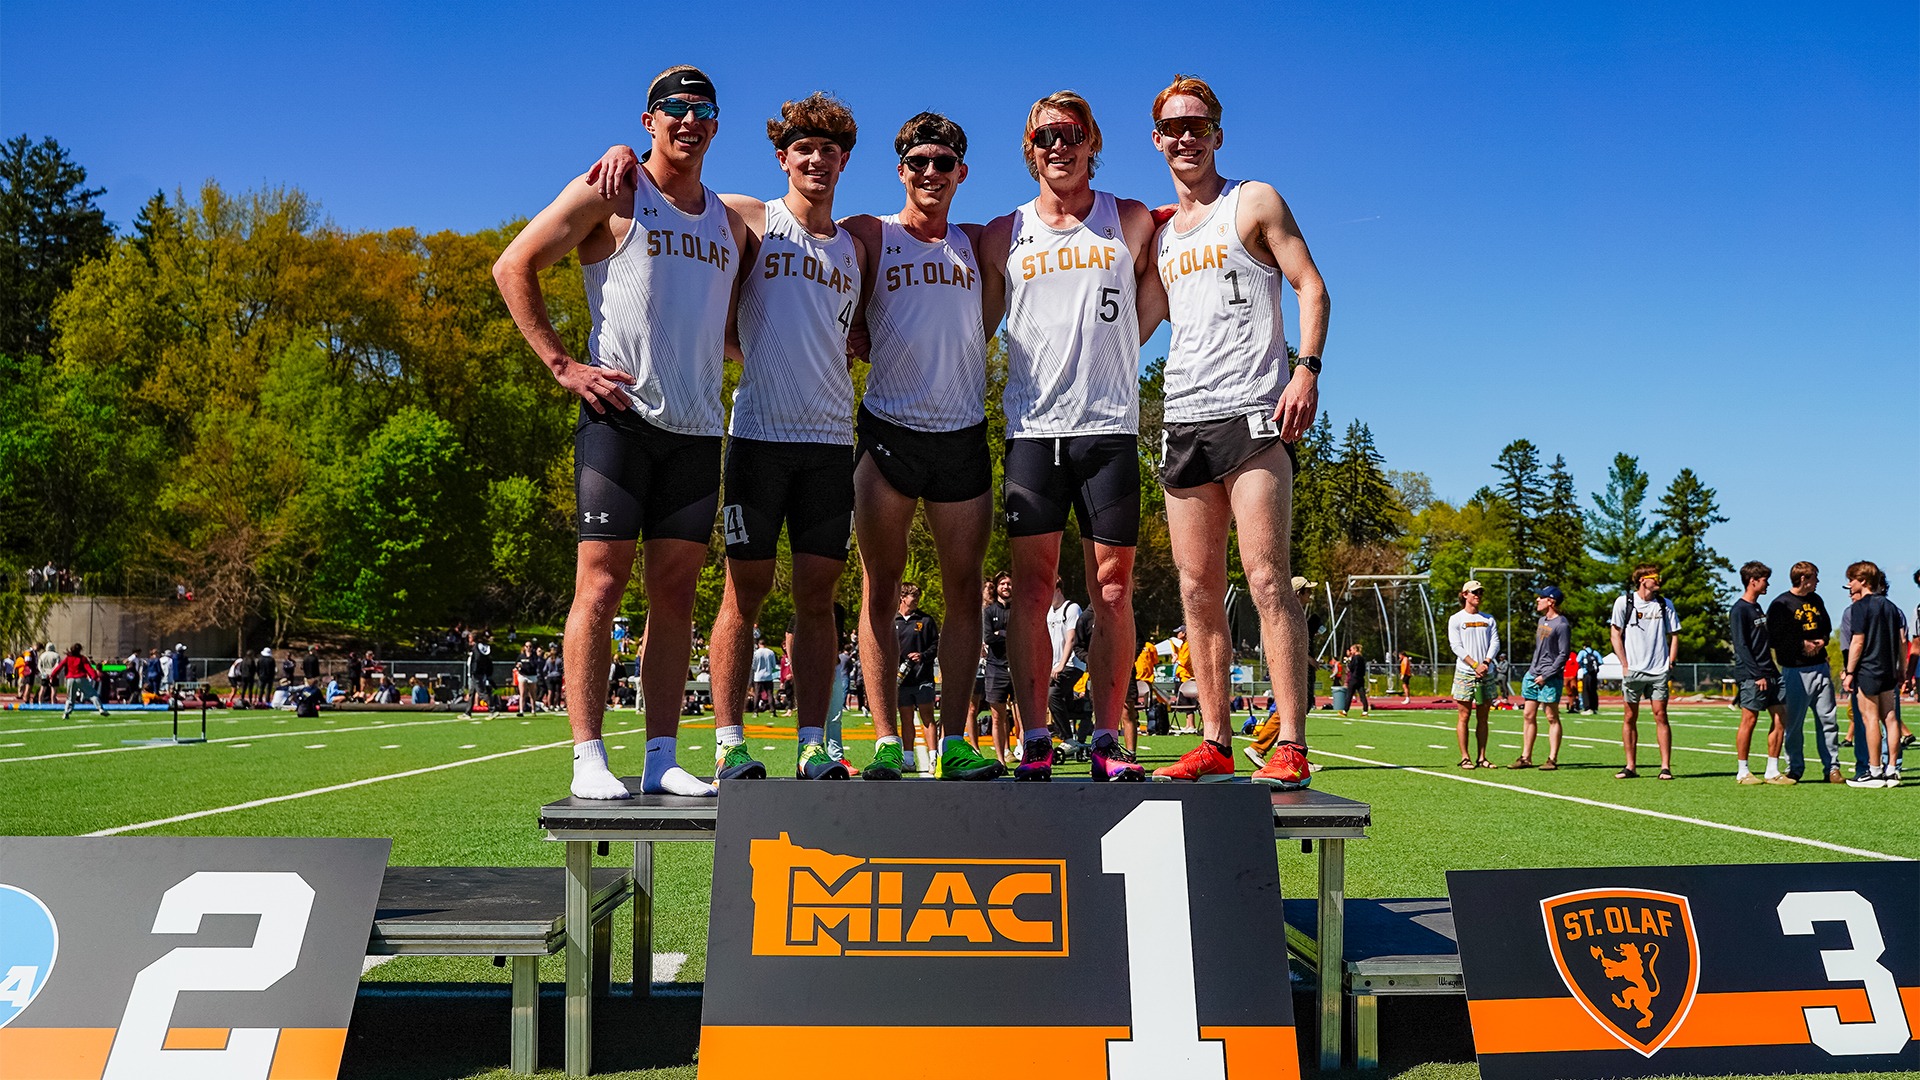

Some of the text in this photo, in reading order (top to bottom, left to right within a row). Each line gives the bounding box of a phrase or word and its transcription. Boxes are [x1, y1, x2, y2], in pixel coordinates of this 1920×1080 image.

[647, 229, 730, 272] ST. OLAF
[1022, 245, 1116, 281] ST. OLAF
[1162, 244, 1228, 290] ST. OLAF
[764, 252, 853, 294] ST. OLAF
[886, 262, 976, 292] ST. OLAF
[1224, 270, 1248, 305] 1
[837, 299, 853, 334] 4
[1099, 287, 1120, 323] 5
[726, 506, 743, 540] 4
[790, 870, 1055, 944] MIAC
[1563, 906, 1673, 941] ST. OLAF
[1100, 799, 1229, 1080] 1
[101, 871, 316, 1080] 2
[1776, 890, 1912, 1056] 3
